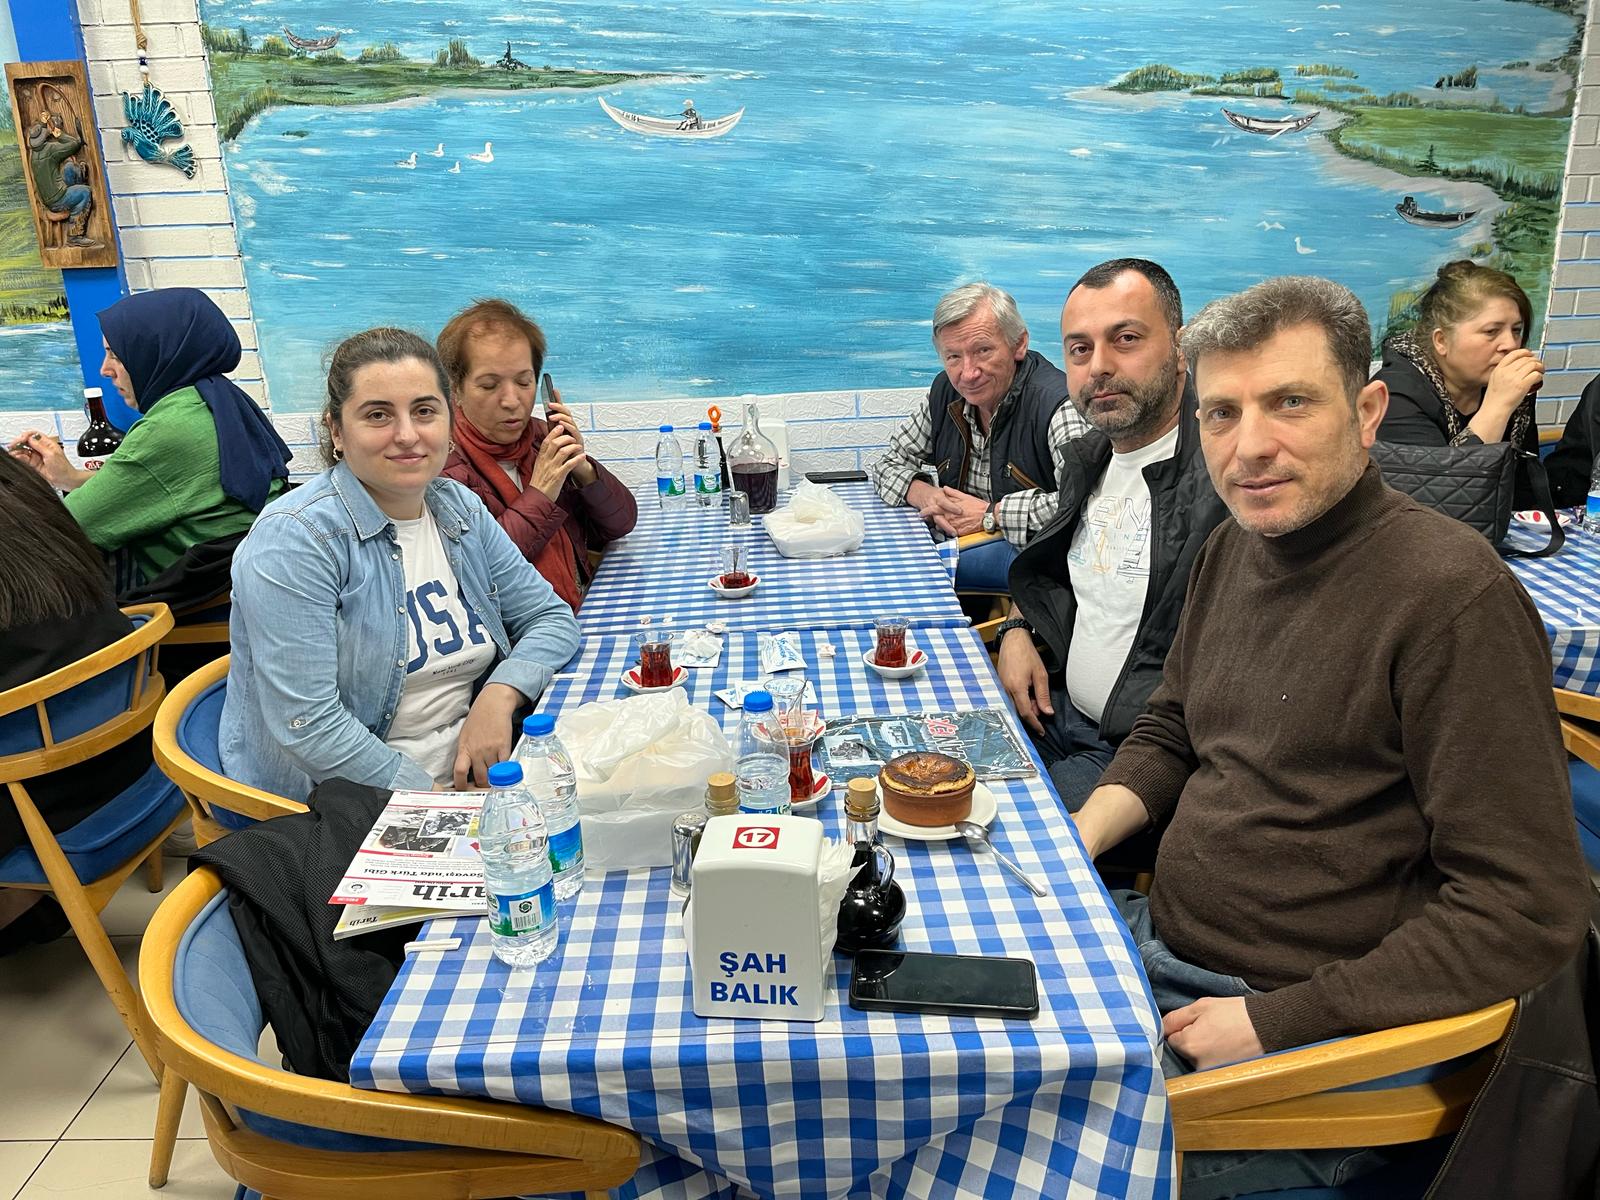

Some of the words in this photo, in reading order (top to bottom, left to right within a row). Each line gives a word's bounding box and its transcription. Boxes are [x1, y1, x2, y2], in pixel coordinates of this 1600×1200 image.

[743, 832, 772, 843] 17
[412, 884, 486, 901] arih
[349, 916, 378, 926] Tarih
[719, 951, 787, 978] ŞAH
[710, 981, 799, 1006] BALIK
